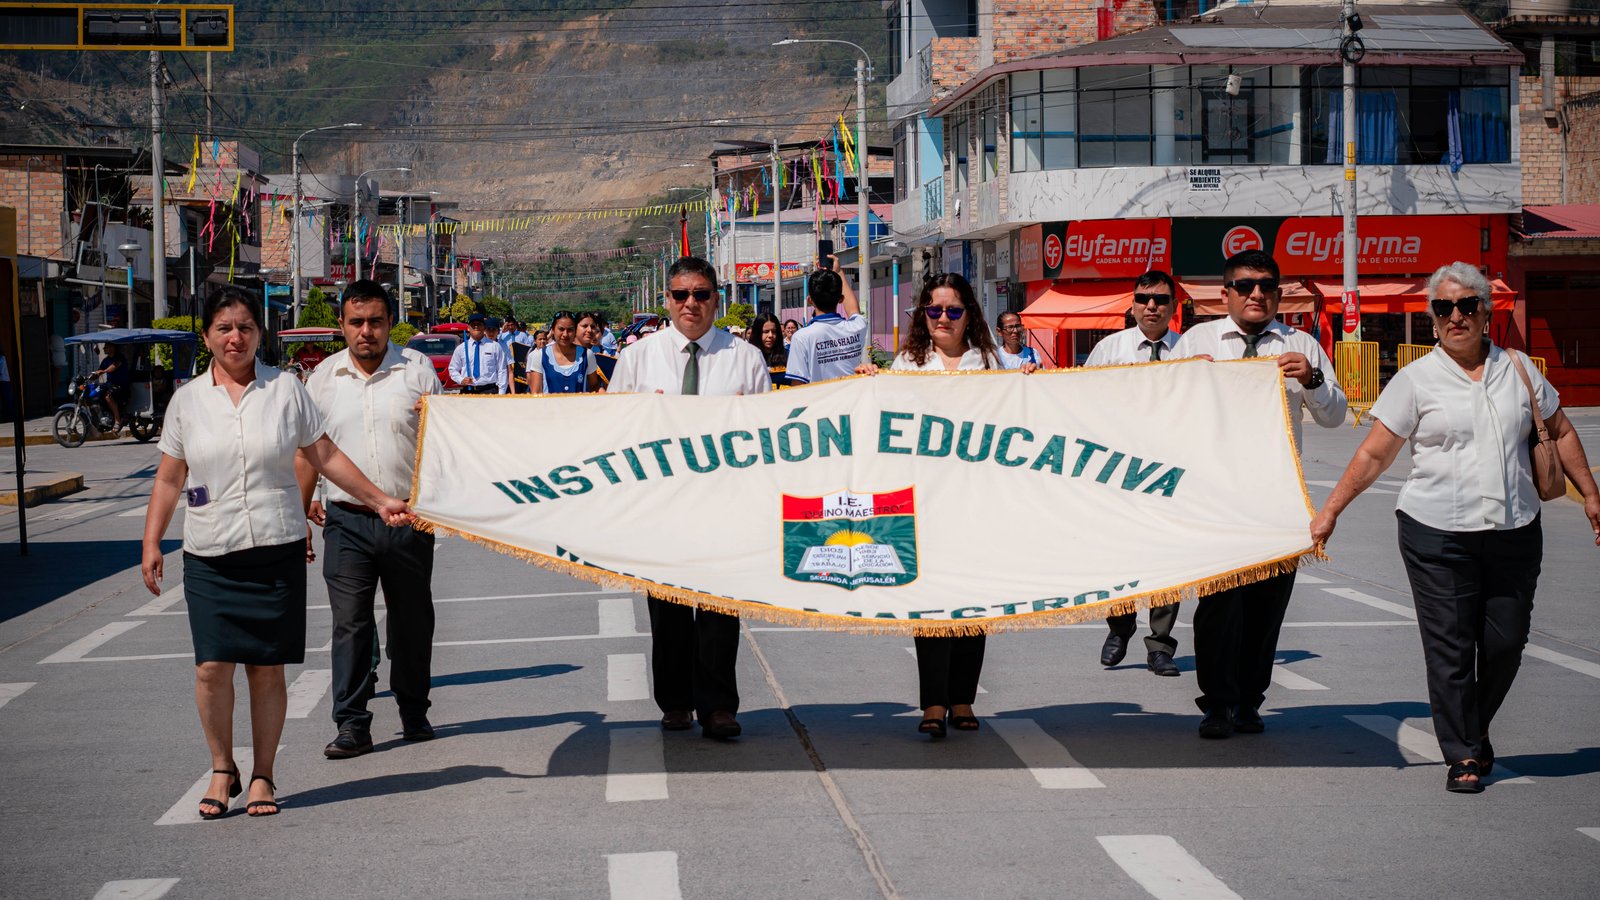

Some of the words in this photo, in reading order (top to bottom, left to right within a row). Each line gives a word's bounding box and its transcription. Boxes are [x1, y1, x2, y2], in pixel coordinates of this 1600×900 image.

[1066, 233, 1167, 262] Elyfarma
[838, 334, 861, 347] SHADAY
[491, 406, 853, 505] INSTITUCIÓN
[877, 410, 1186, 498] EDUCATIVA
[838, 496, 863, 507] I.E.
[810, 575, 848, 584] SEGUNDA
[850, 575, 896, 586] JERUSALÉN
